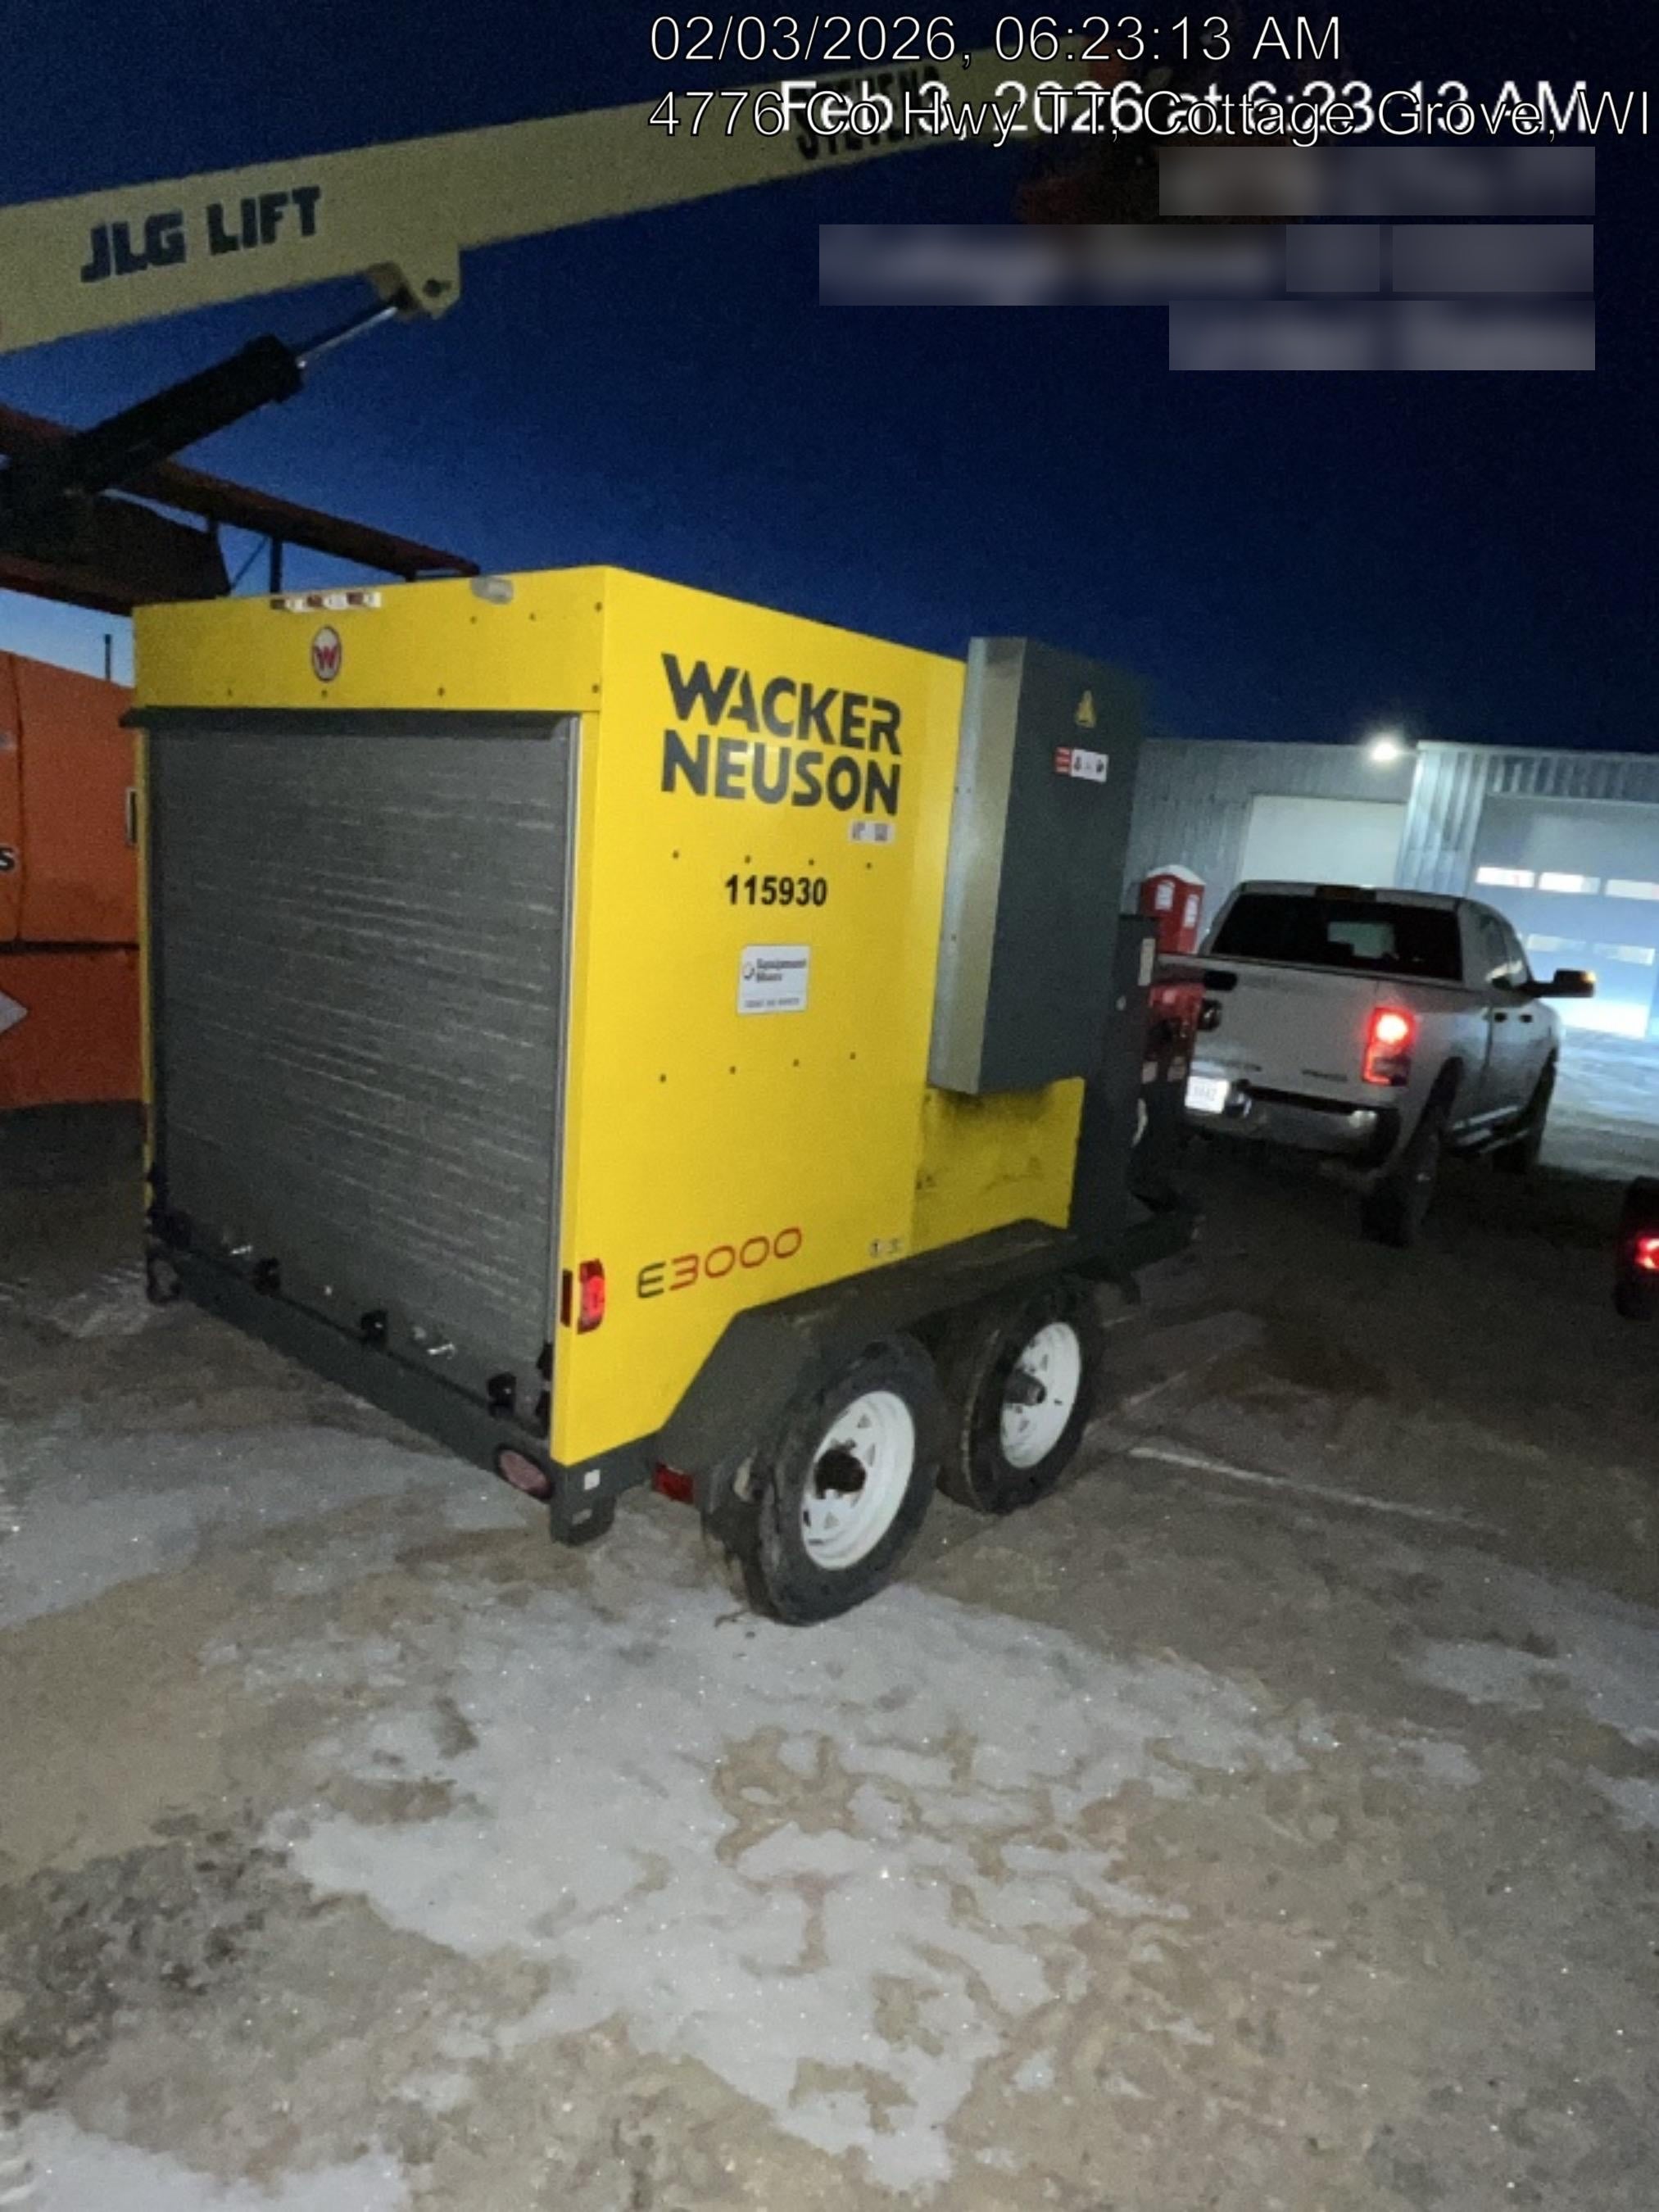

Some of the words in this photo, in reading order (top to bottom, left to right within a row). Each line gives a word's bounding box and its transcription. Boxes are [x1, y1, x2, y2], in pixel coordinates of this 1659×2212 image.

[81, 210, 187, 283] JLG
[206, 186, 322, 256] LIFT
[660, 652, 902, 756] WACKER
[660, 729, 901, 817] NEUSON
[724, 874, 828, 908] 115930
[637, 1226, 803, 1299] E3000
